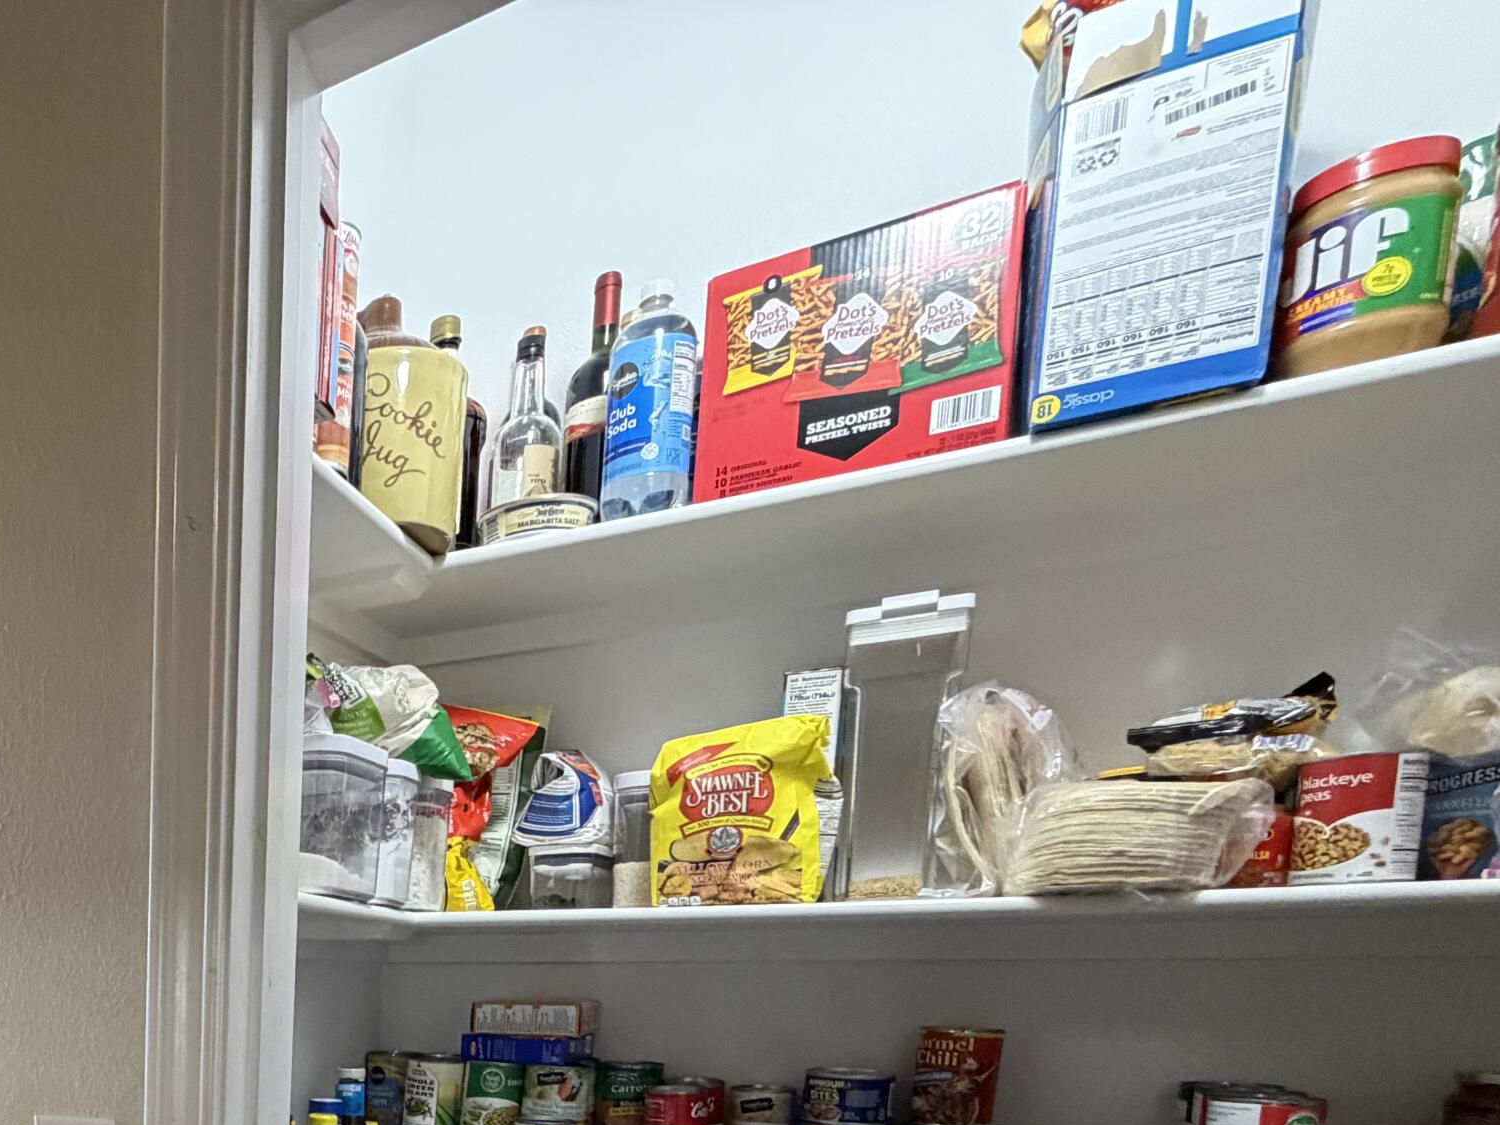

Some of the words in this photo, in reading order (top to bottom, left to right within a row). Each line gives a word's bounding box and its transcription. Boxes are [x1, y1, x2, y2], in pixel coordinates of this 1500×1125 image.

[756, 304, 789, 325] Dot's
[838, 302, 877, 322] Dot's
[927, 297, 965, 319] Dot's
[749, 318, 796, 341] Pretzels
[826, 321, 880, 341] Pretzels
[919, 313, 972, 337] Pretzels
[1149, 326, 1169, 337] 160
[1176, 319, 1197, 331] 160
[1096, 338, 1117, 349] 160
[1122, 332, 1143, 343] 160
[1046, 350, 1066, 361] 150
[1071, 345, 1091, 355] 150
[1062, 389, 1115, 410] classic
[608, 403, 637, 425] Club
[1036, 402, 1054, 418] 18
[607, 417, 638, 440] Soda
[806, 405, 892, 436] SEASONED
[804, 428, 851, 446] PRETZEL
[851, 418, 892, 435] TWISTS
[715, 466, 728, 478] 14
[713, 478, 728, 490] 10
[516, 517, 563, 529] MARGARITA
[564, 518, 581, 526] SALT
[685, 771, 769, 808] SHAWNEE
[1301, 771, 1374, 791] blackeye
[701, 790, 752, 819] BEST
[1300, 789, 1333, 804] peas
[917, 1049, 960, 1067] Chili
